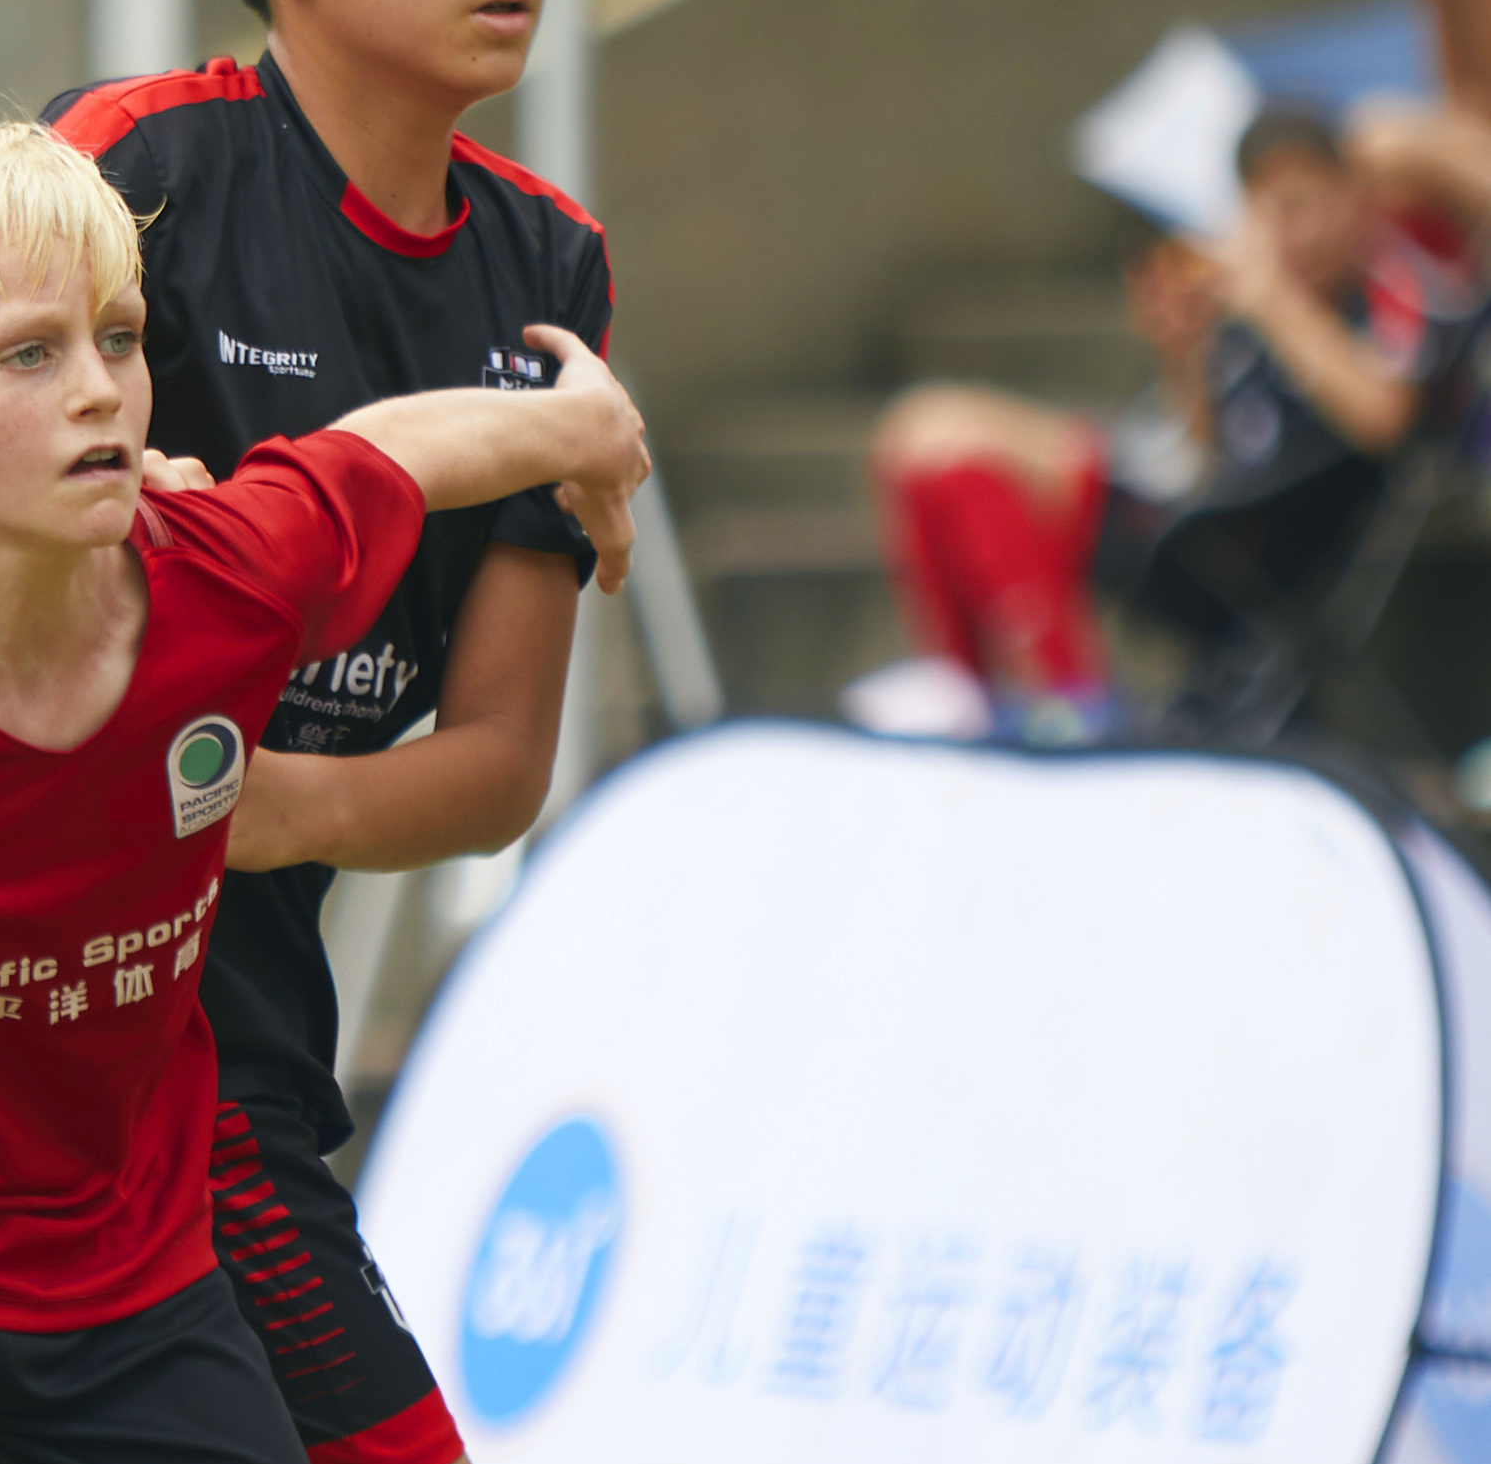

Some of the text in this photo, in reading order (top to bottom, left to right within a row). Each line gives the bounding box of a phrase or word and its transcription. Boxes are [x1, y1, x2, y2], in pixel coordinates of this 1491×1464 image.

[219, 329, 318, 367] INTEGRITY
[180, 779, 240, 812] PACIFIC
[182, 790, 240, 825] SPORTS
[83, 877, 219, 968] Sports
[648, 1203, 1302, 1446] 儿童运动装备
